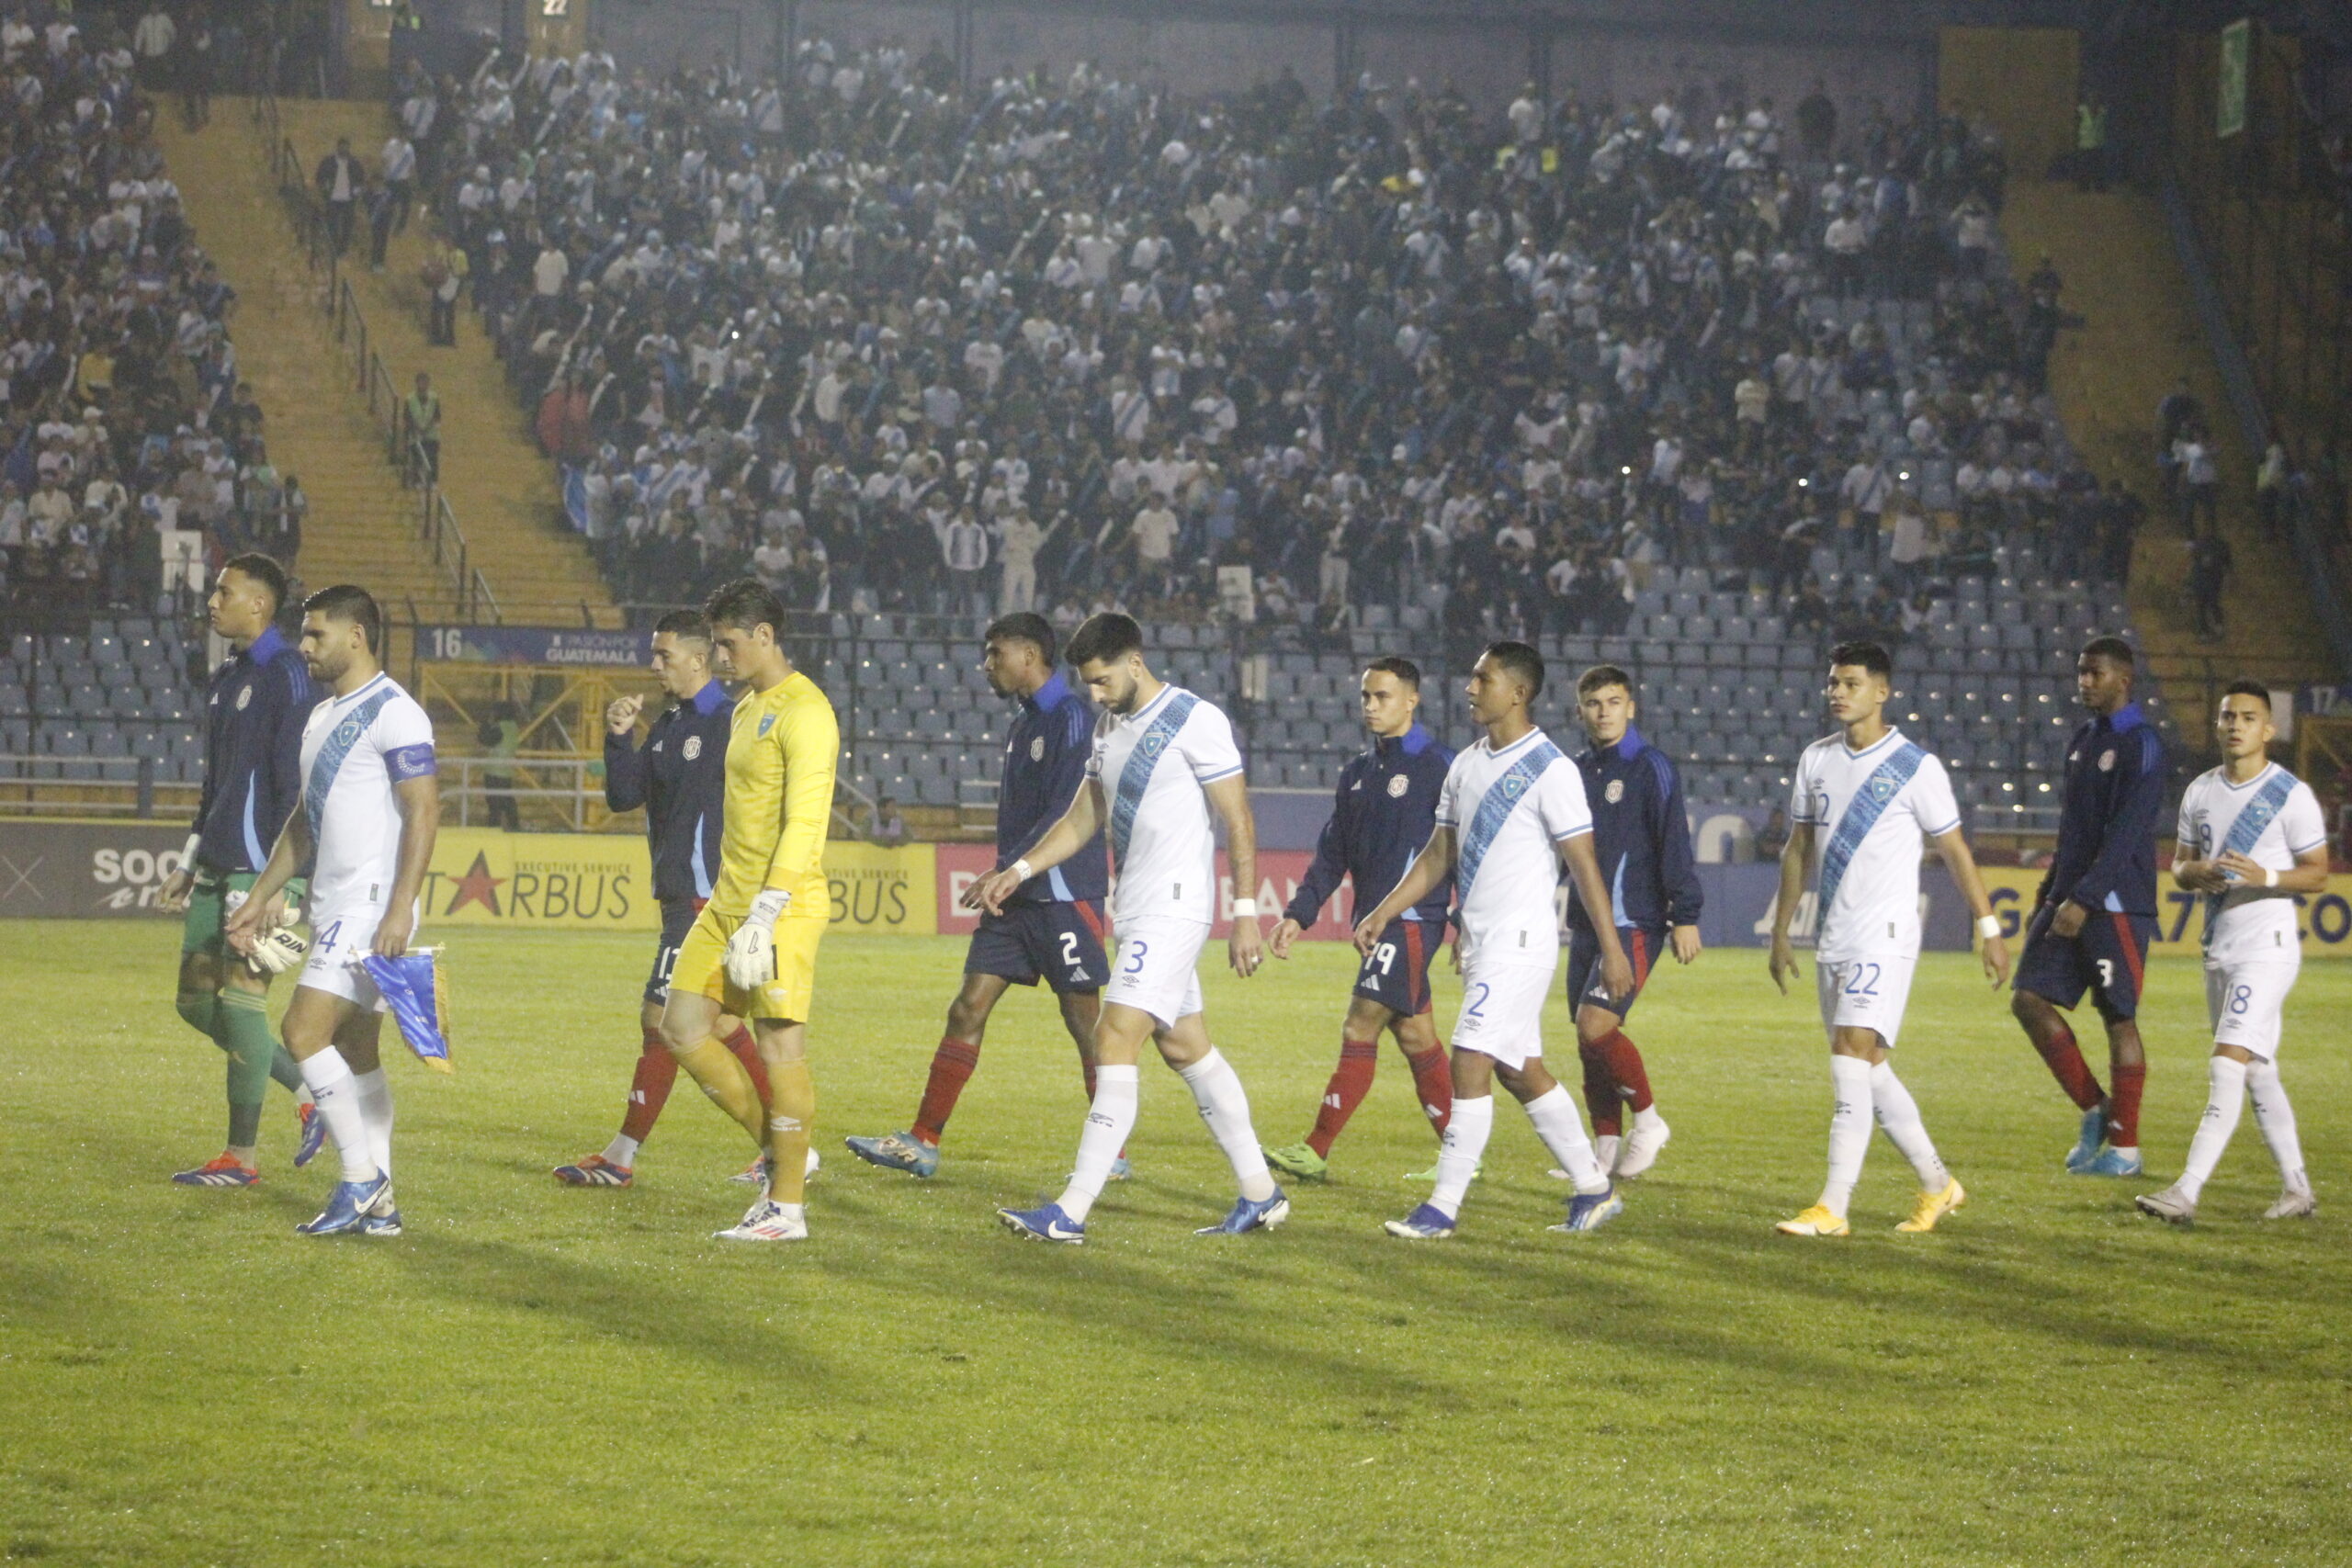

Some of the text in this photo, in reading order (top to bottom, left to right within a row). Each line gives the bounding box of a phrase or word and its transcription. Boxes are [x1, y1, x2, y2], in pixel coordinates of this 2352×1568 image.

[433, 628, 462, 659] 16
[545, 648, 638, 663] GUATEMALA
[2312, 686, 2336, 715] 17
[514, 862, 631, 874] EXECUTIVE SERVICE
[319, 920, 342, 953] 4
[1059, 931, 1081, 965] 2
[1125, 941, 1148, 974] 3
[1364, 942, 1396, 976] 19
[1845, 963, 1881, 996] 22
[1468, 982, 1489, 1017] 2
[2224, 982, 2252, 1015] 18
